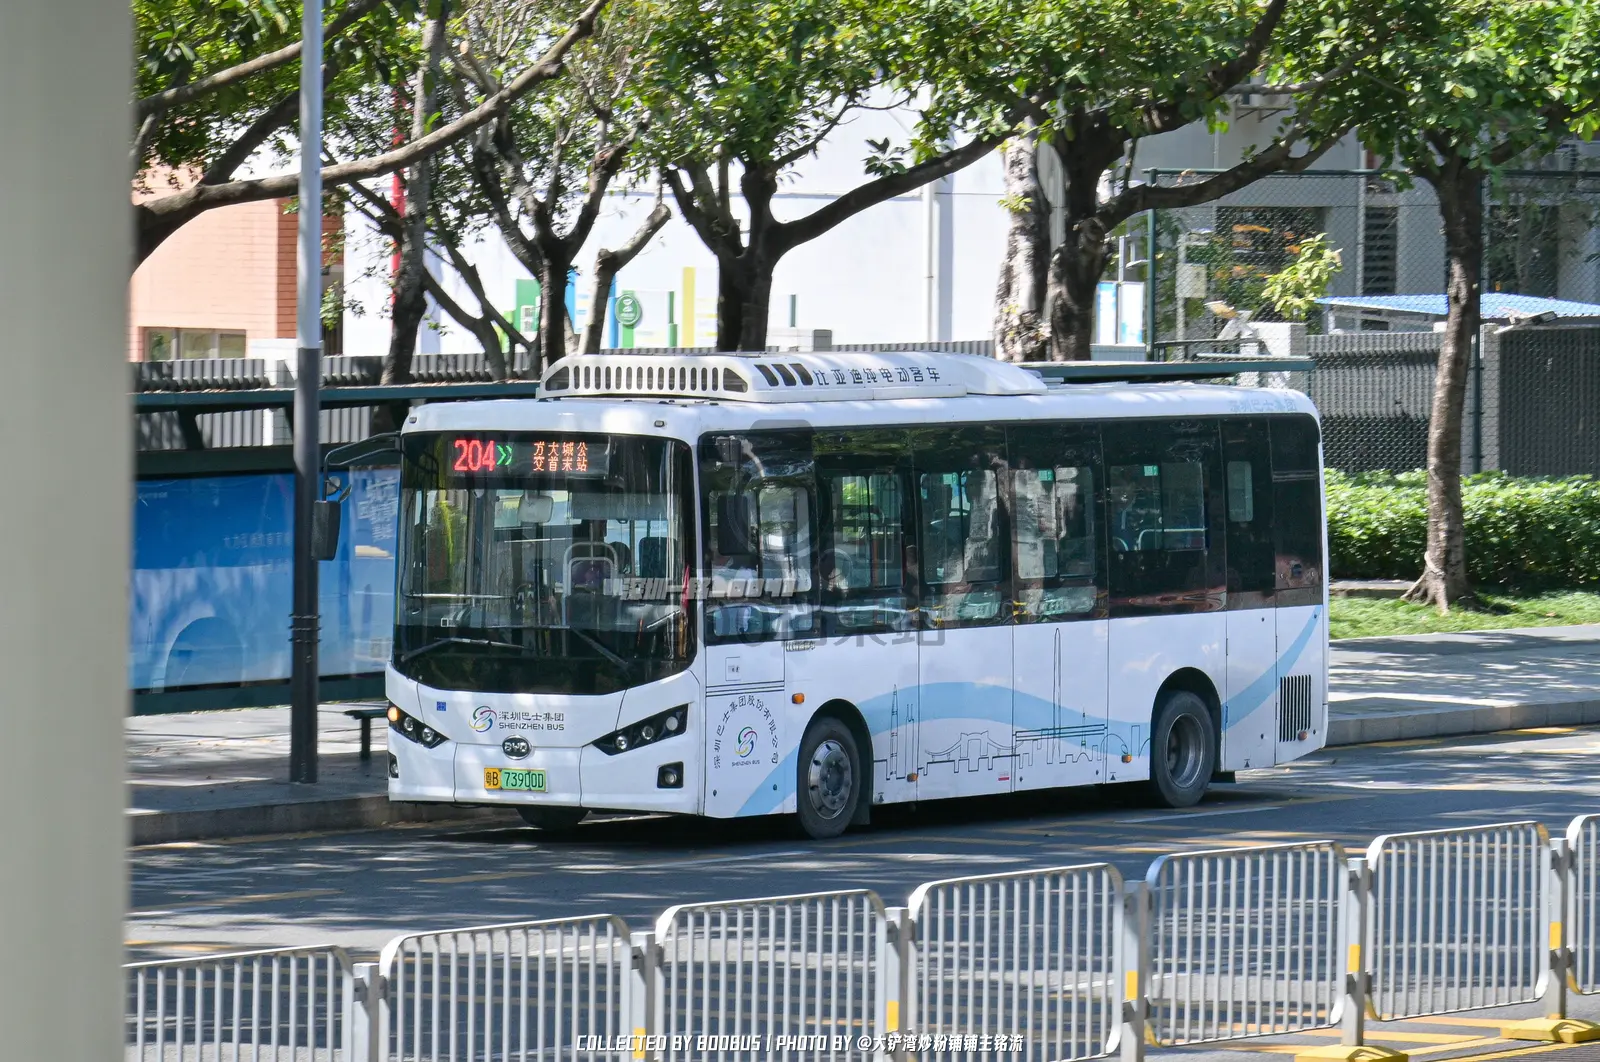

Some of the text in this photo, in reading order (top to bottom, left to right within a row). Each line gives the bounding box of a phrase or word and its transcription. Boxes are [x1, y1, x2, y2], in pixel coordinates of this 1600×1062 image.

[812, 366, 941, 386] 比亚迪纯电动客车
[453, 439, 496, 472] 204
[533, 441, 589, 456] 方大城公
[498, 711, 564, 721] 深圳巴士集团
[499, 722, 565, 731] SHENZHEN BUS
